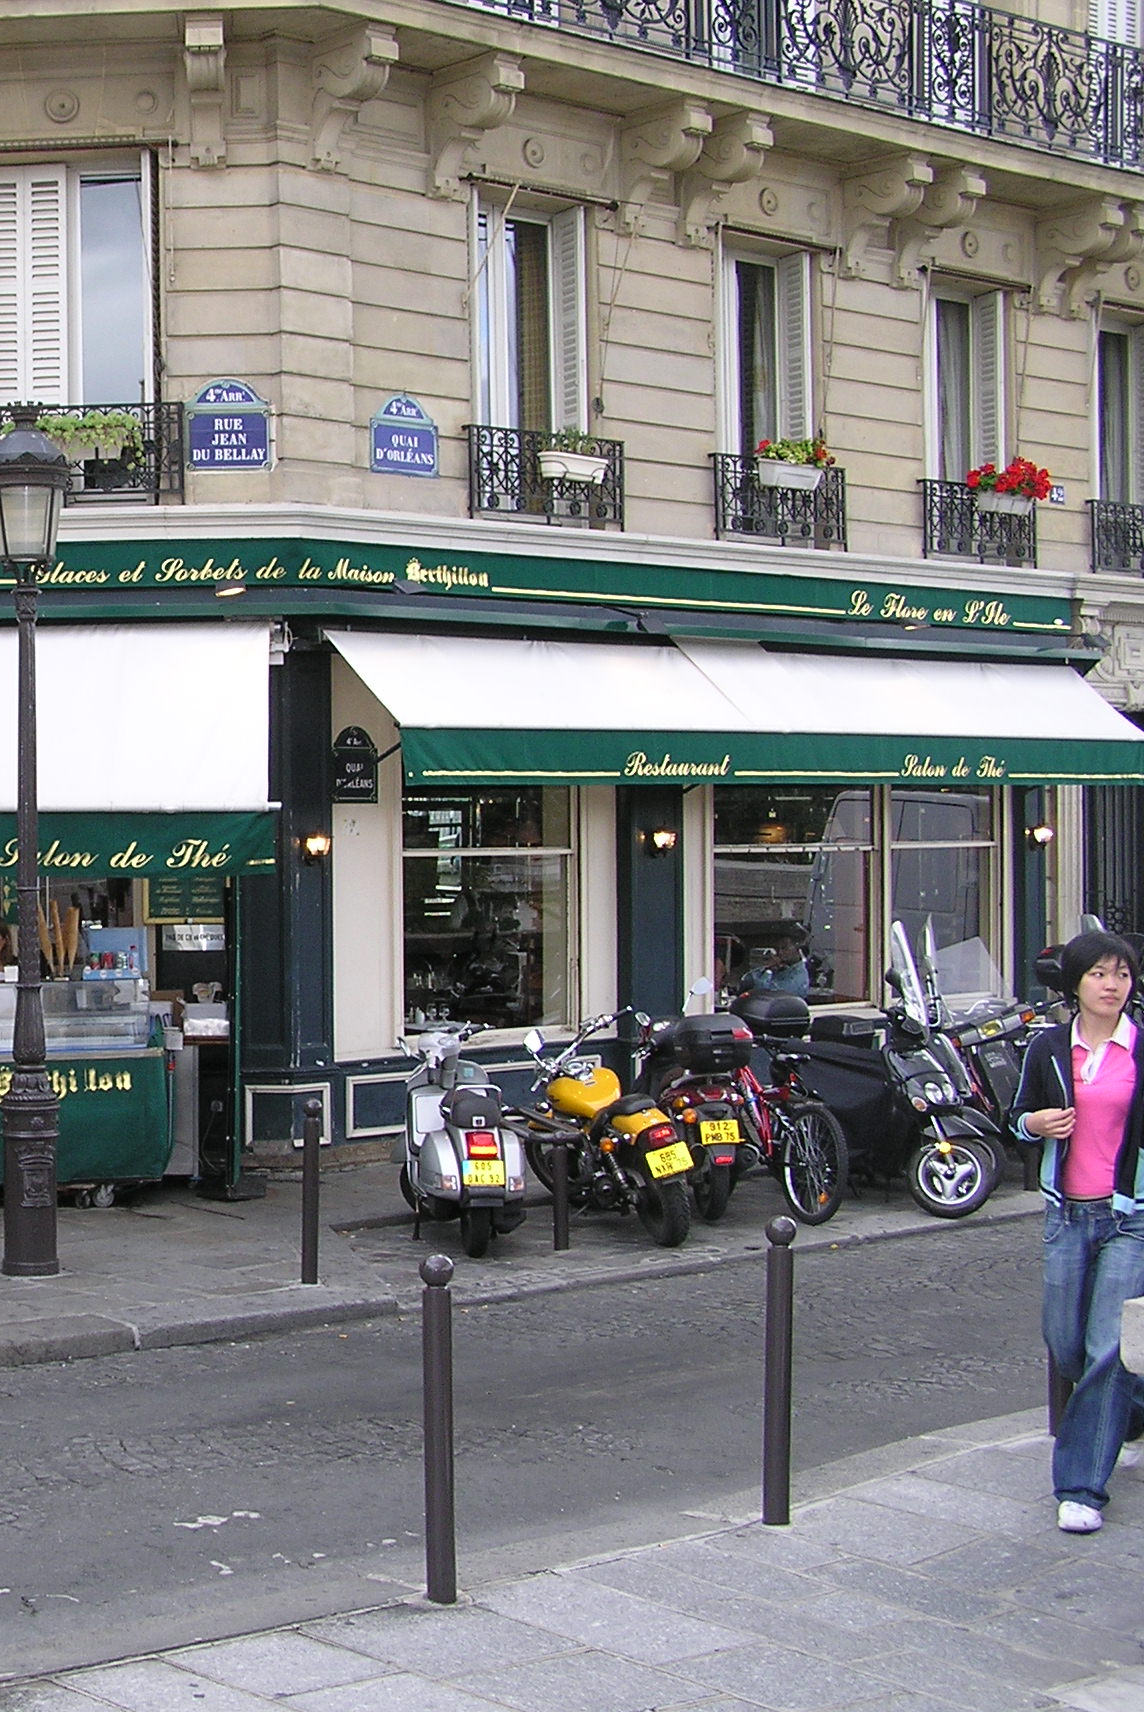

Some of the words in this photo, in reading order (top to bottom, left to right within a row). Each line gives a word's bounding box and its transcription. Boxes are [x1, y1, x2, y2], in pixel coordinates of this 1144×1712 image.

[214, 418, 243, 430] RUE
[212, 433, 247, 446] JEAN
[391, 434, 419, 448] QUAI
[193, 449, 210, 461] DU
[214, 448, 266, 461] BELLAY
[1051, 487, 1064, 501] 42
[119, 561, 145, 582] et
[155, 559, 247, 581] Sorbets
[256, 558, 286, 578] de
[299, 558, 322, 579] la
[328, 559, 394, 583] Maison
[406, 558, 488, 590] Berthillon
[848, 590, 873, 616] Le
[881, 593, 928, 620] Flore
[934, 609, 956, 621] en
[624, 752, 729, 776] Restaurant
[901, 755, 946, 777] Salon
[952, 757, 969, 776] de
[977, 756, 1004, 777] Thé
[110, 842, 153, 868] de
[167, 839, 231, 867] Thé
[724, 1131, 736, 1141] 75
